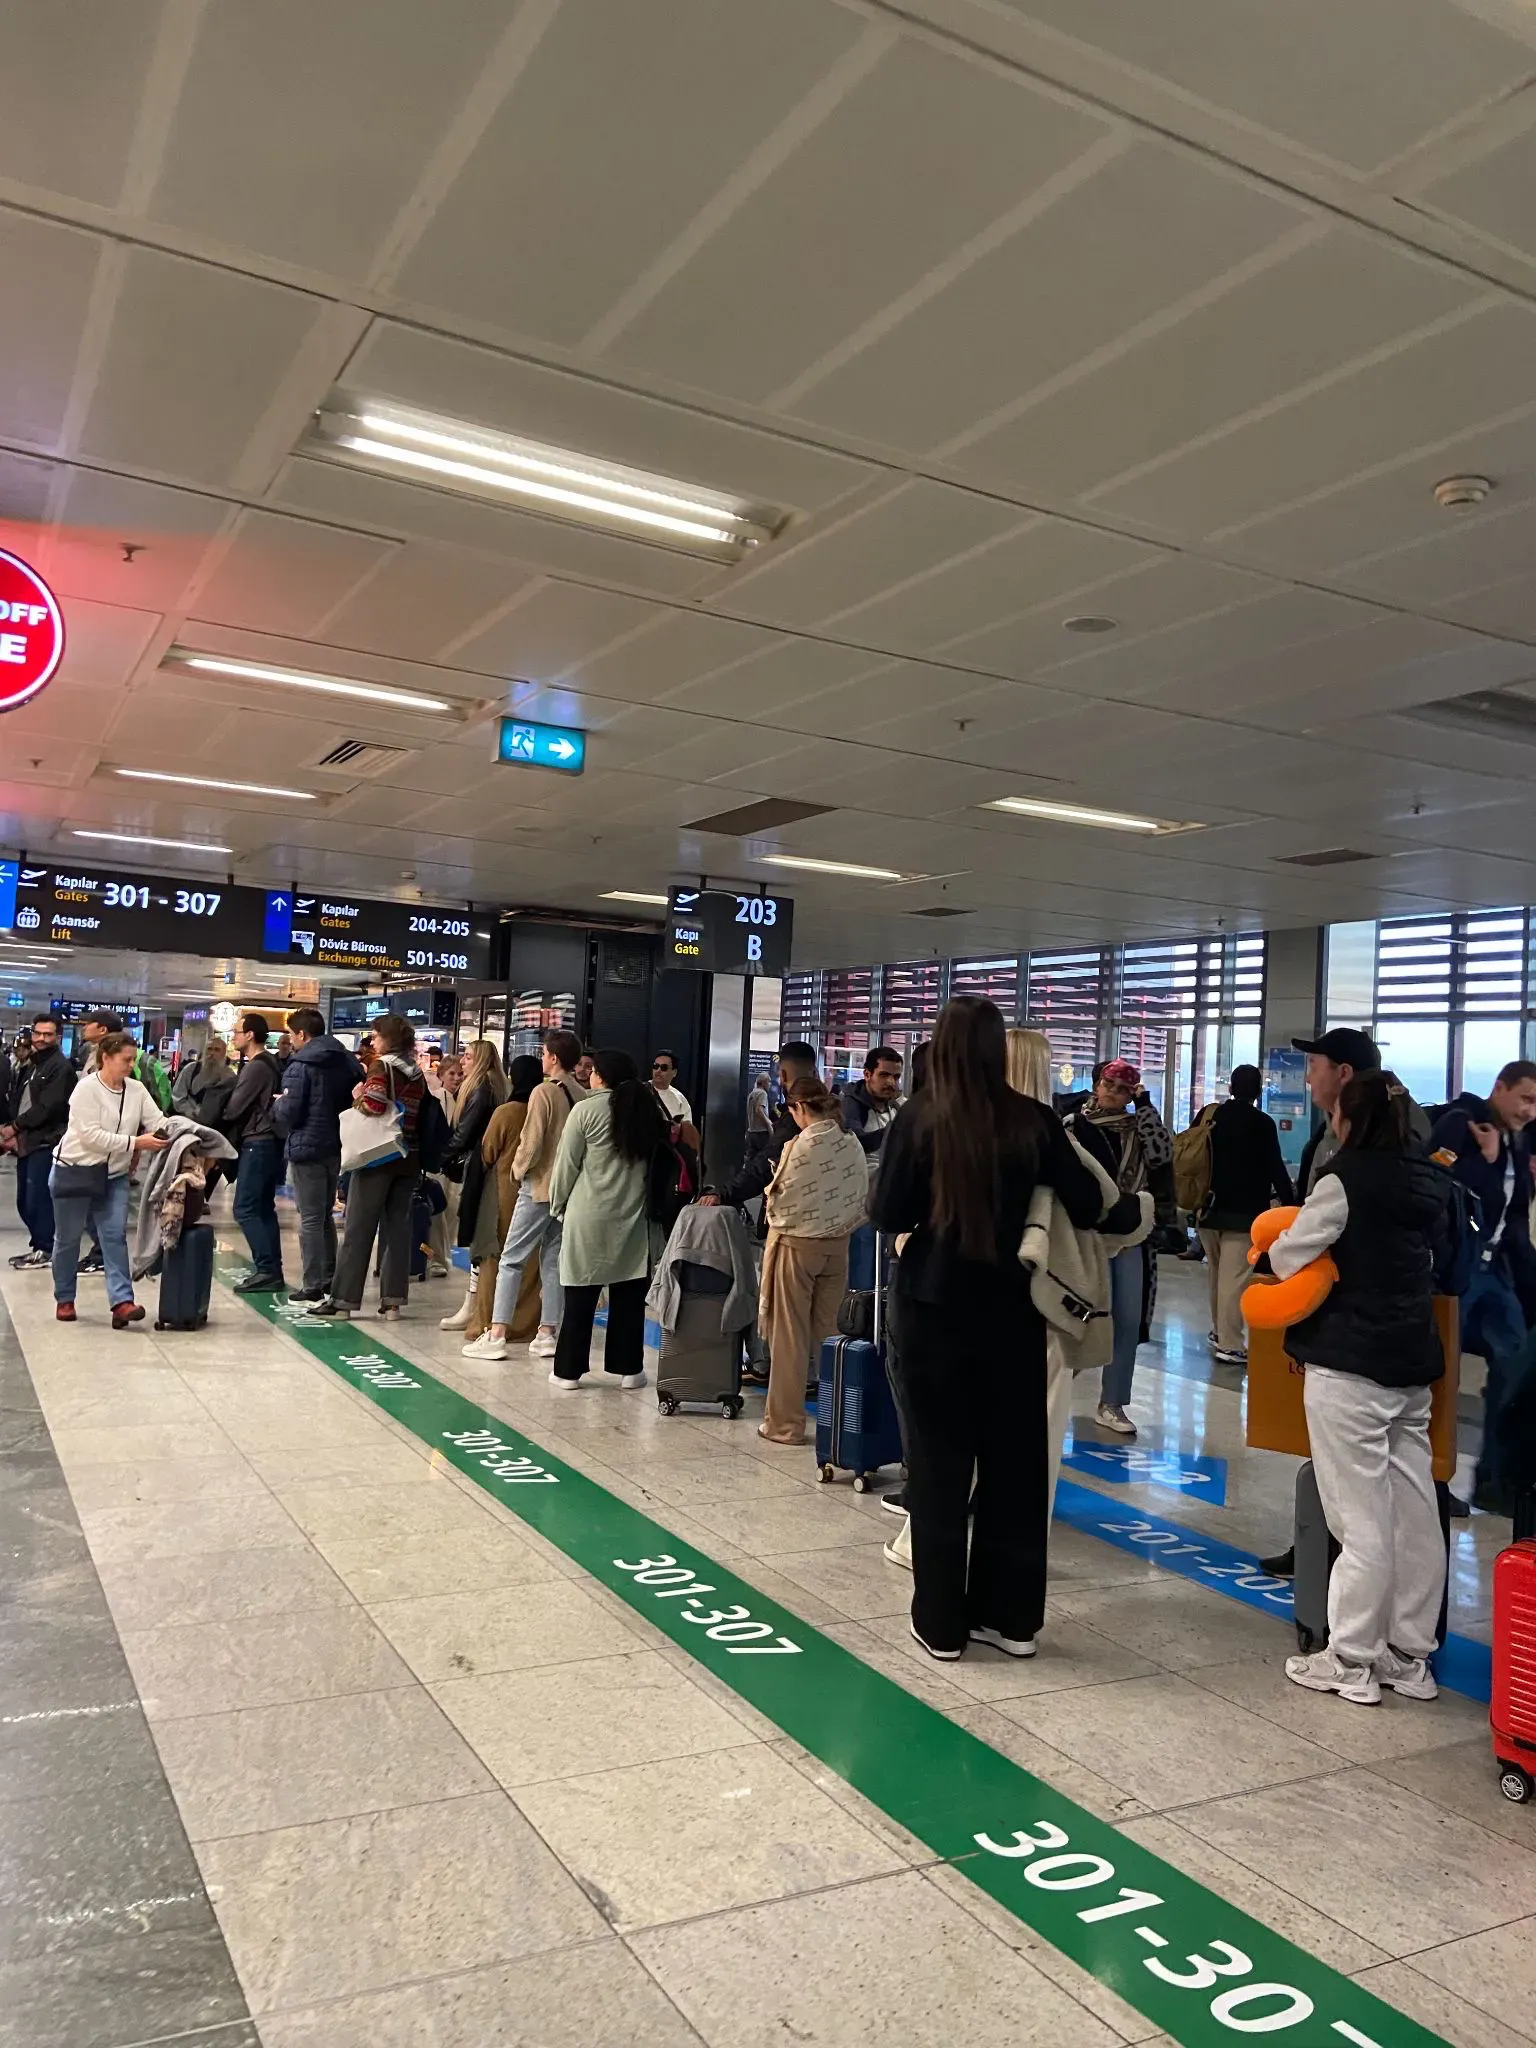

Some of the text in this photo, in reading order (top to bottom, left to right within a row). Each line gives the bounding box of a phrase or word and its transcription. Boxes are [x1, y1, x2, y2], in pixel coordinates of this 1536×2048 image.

[55, 875, 98, 890] Kapılar
[55, 889, 89, 903] Gates
[104, 883, 149, 909] 301
[174, 891, 221, 916] 307
[321, 903, 359, 917] Kapılar
[735, 897, 777, 926] 203
[51, 914, 100, 929] Asansör
[320, 916, 351, 929] Gates
[409, 916, 470, 937] 204-205
[51, 928, 72, 940] Lift
[675, 928, 699, 942] Kapı
[319, 938, 387, 954] Döviz Bürosu
[674, 943, 699, 955] Gate
[747, 935, 762, 961] B
[318, 951, 401, 968] Exchange Office
[406, 950, 468, 970] 501-508
[338, 1353, 422, 1389] 301-307
[442, 1429, 560, 1484] 301-307
[1082, 1448, 1211, 1485] 203
[613, 1554, 804, 1655] 301-307
[973, 1820, 1384, 2048] 301-30
